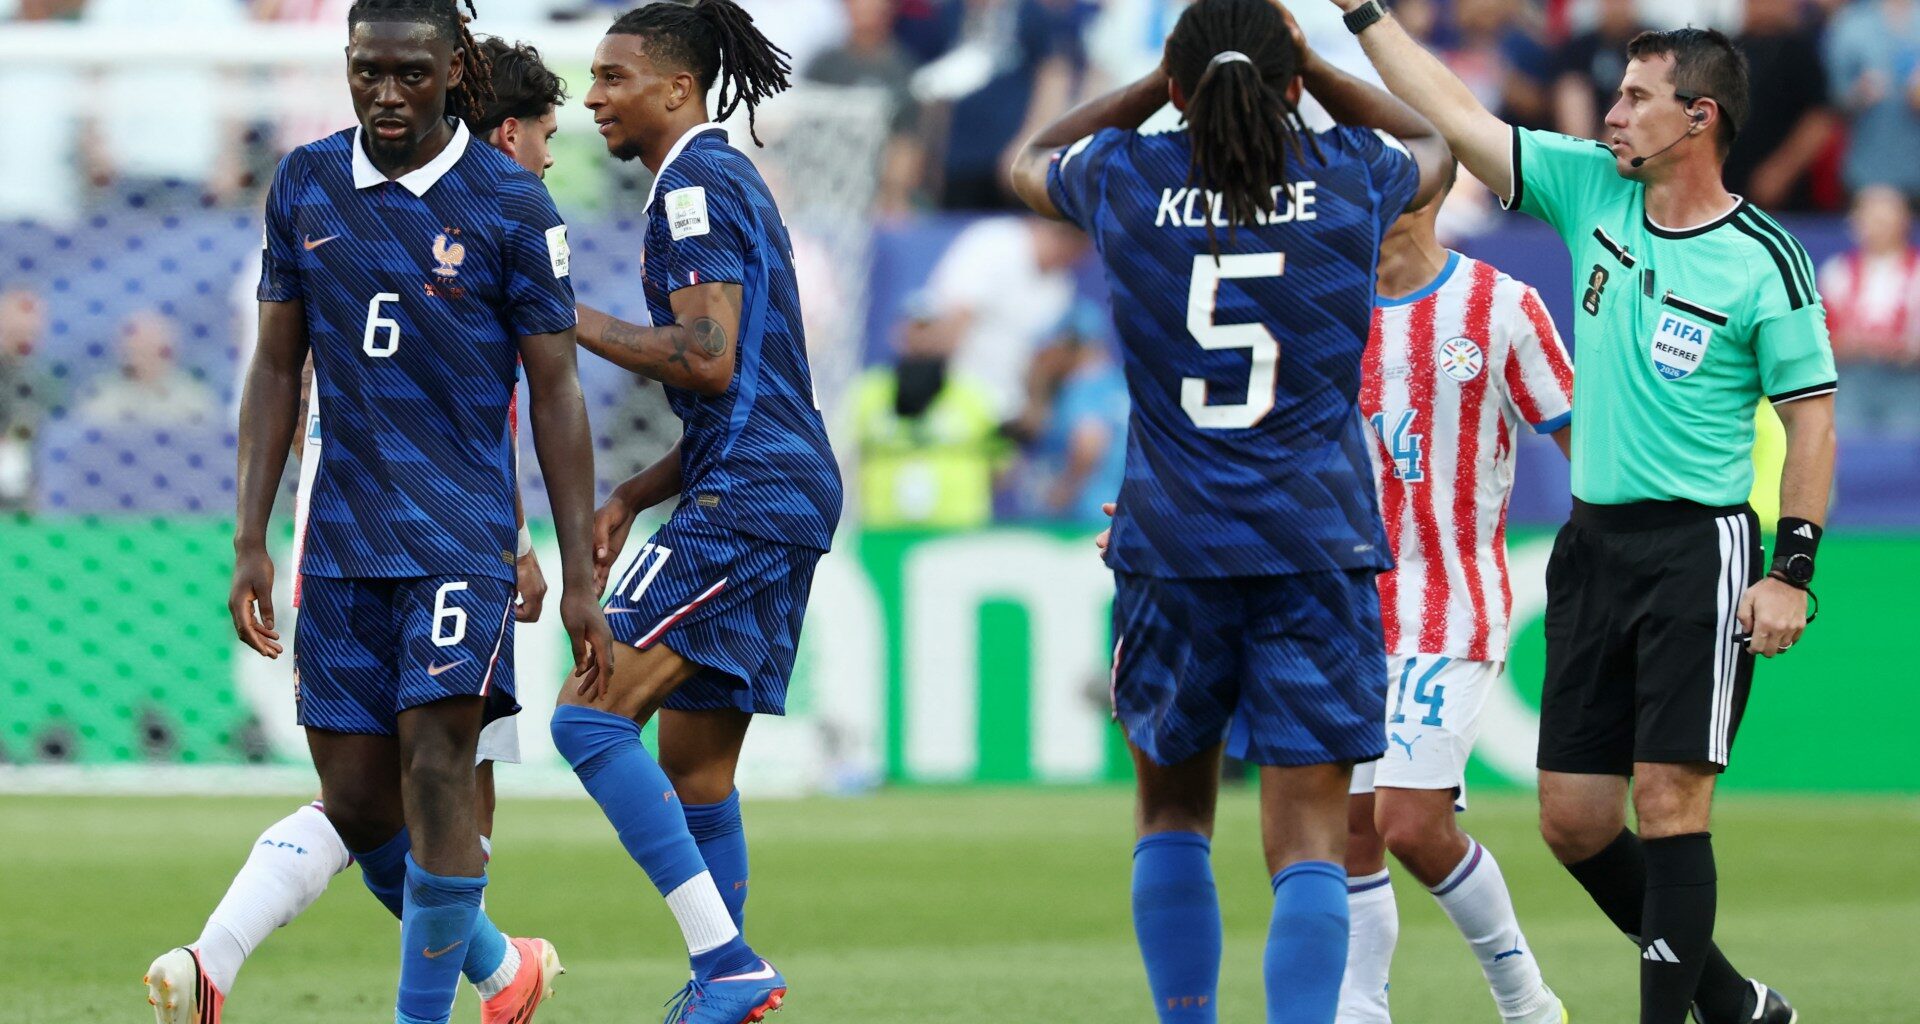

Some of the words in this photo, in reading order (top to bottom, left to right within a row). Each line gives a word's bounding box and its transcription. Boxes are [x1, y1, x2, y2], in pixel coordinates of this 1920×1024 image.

[363, 292, 400, 358] 6
[1180, 252, 1286, 429] 5
[1655, 341, 1698, 362] REFEREE
[1662, 317, 1702, 345] FIFA
[1660, 364, 1680, 377] 2026
[1370, 409, 1424, 482] 14
[614, 543, 672, 602] 11
[431, 581, 468, 647] 6
[1389, 656, 1451, 727] 14
